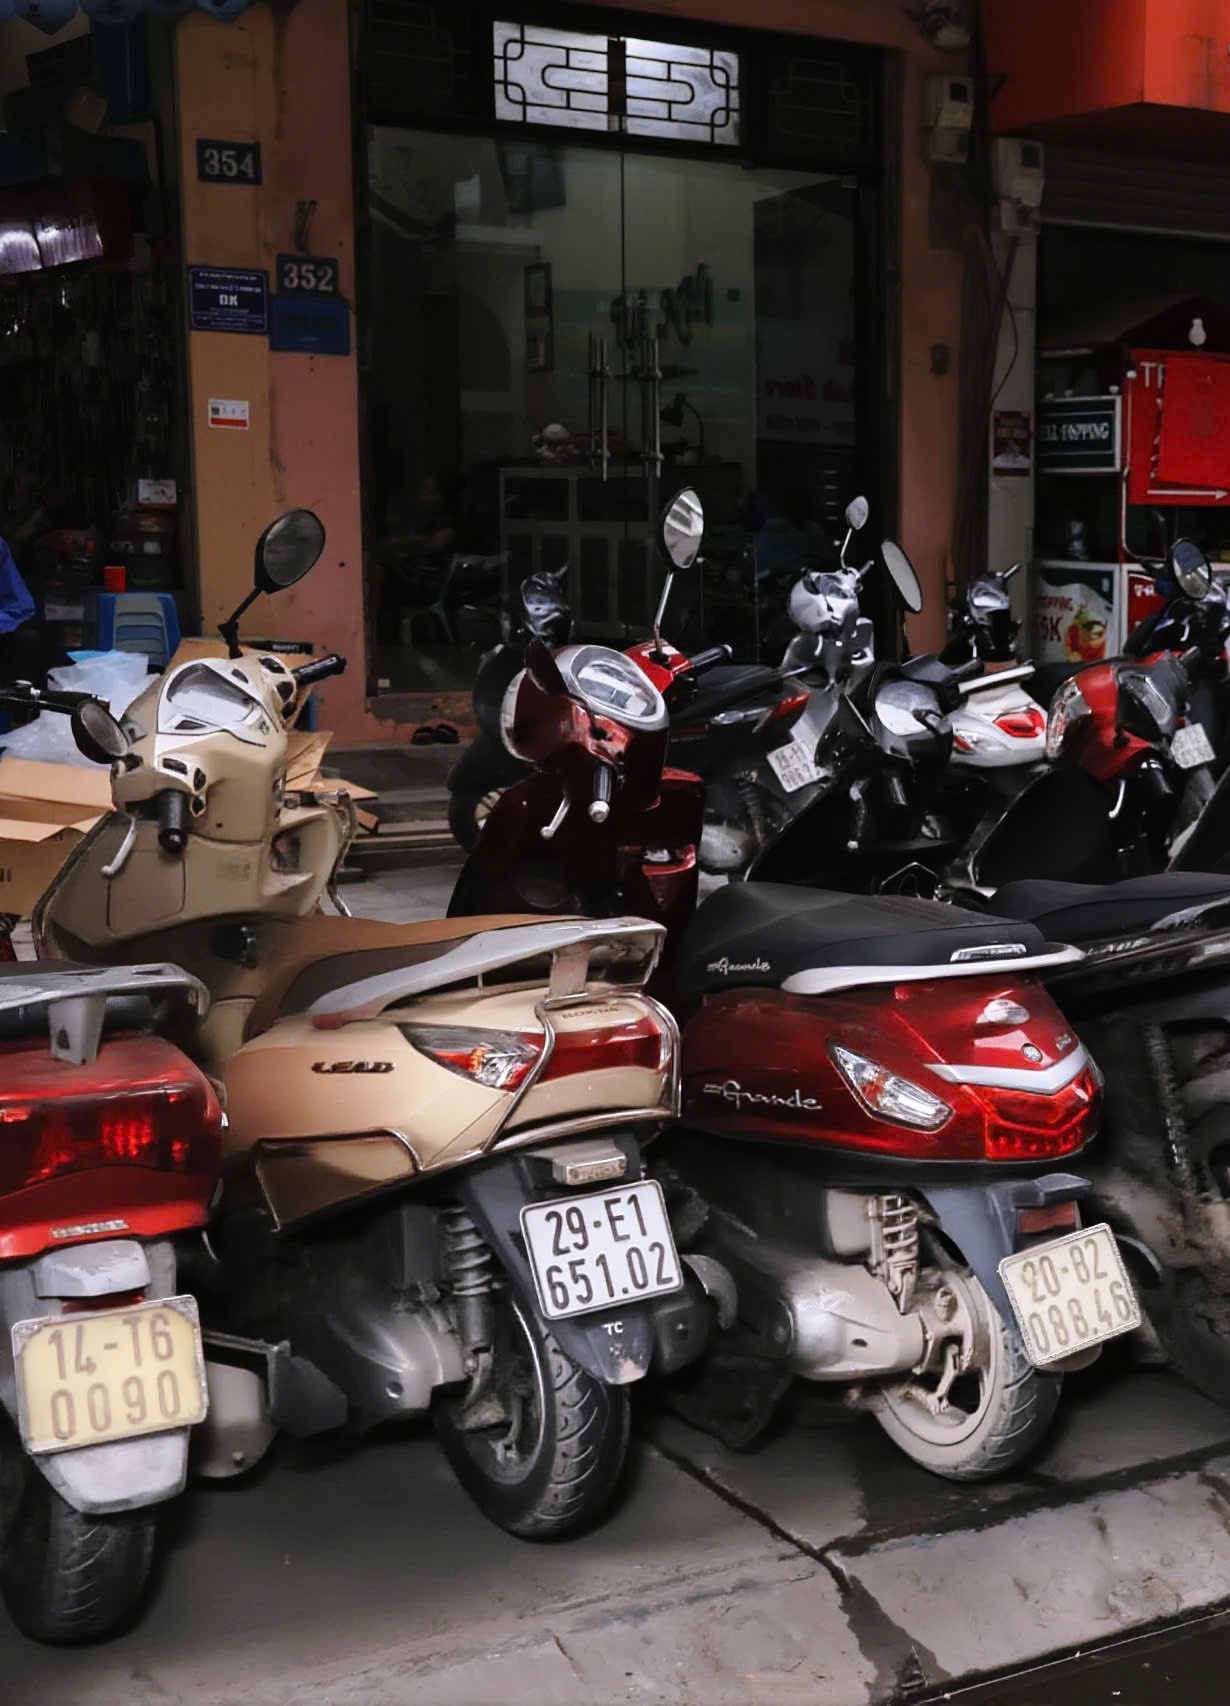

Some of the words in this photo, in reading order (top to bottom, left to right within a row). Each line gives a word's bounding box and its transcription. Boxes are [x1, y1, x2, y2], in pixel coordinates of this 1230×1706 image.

[204, 148, 256, 178] 354
[283, 264, 335, 292] 352
[311, 1061, 394, 1074] LEAD
[702, 1079, 824, 1110] Grande
[545, 1193, 648, 1257] 29-E1
[546, 1241, 674, 1310] 651.02
[48, 1312, 174, 1380] 14-T6
[1028, 1280, 1132, 1355] 088.46
[50, 1369, 181, 1440] 0090
